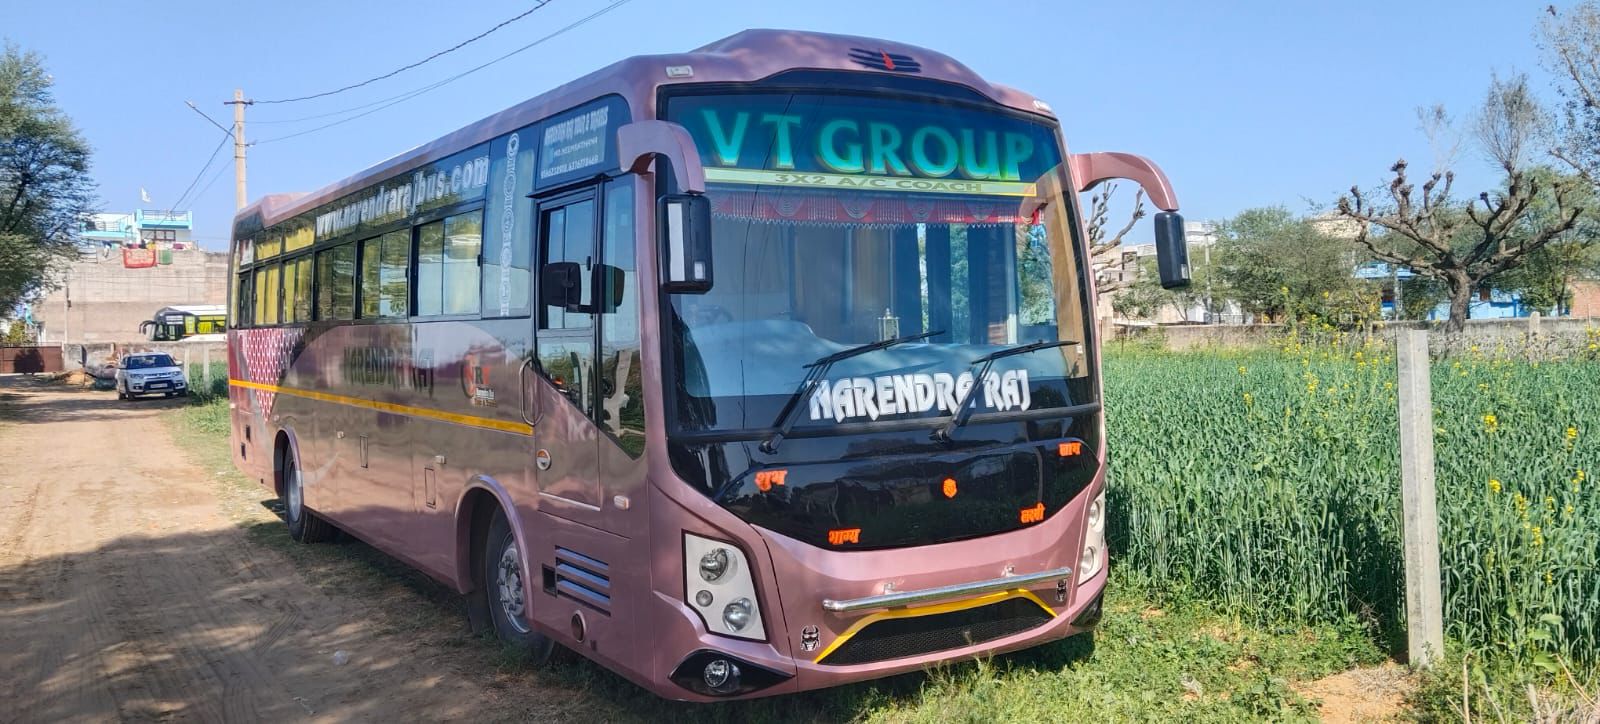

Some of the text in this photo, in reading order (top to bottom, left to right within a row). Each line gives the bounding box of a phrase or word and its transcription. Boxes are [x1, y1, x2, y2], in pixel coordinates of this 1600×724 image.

[817, 118, 1034, 182] GROUP
[316, 154, 489, 238] www.narendrarajbus.com
[775, 173, 982, 193] 3X2 A/C COACH
[806, 368, 1031, 424] NARENDRA RAJ
[755, 468, 788, 492] शुभ
